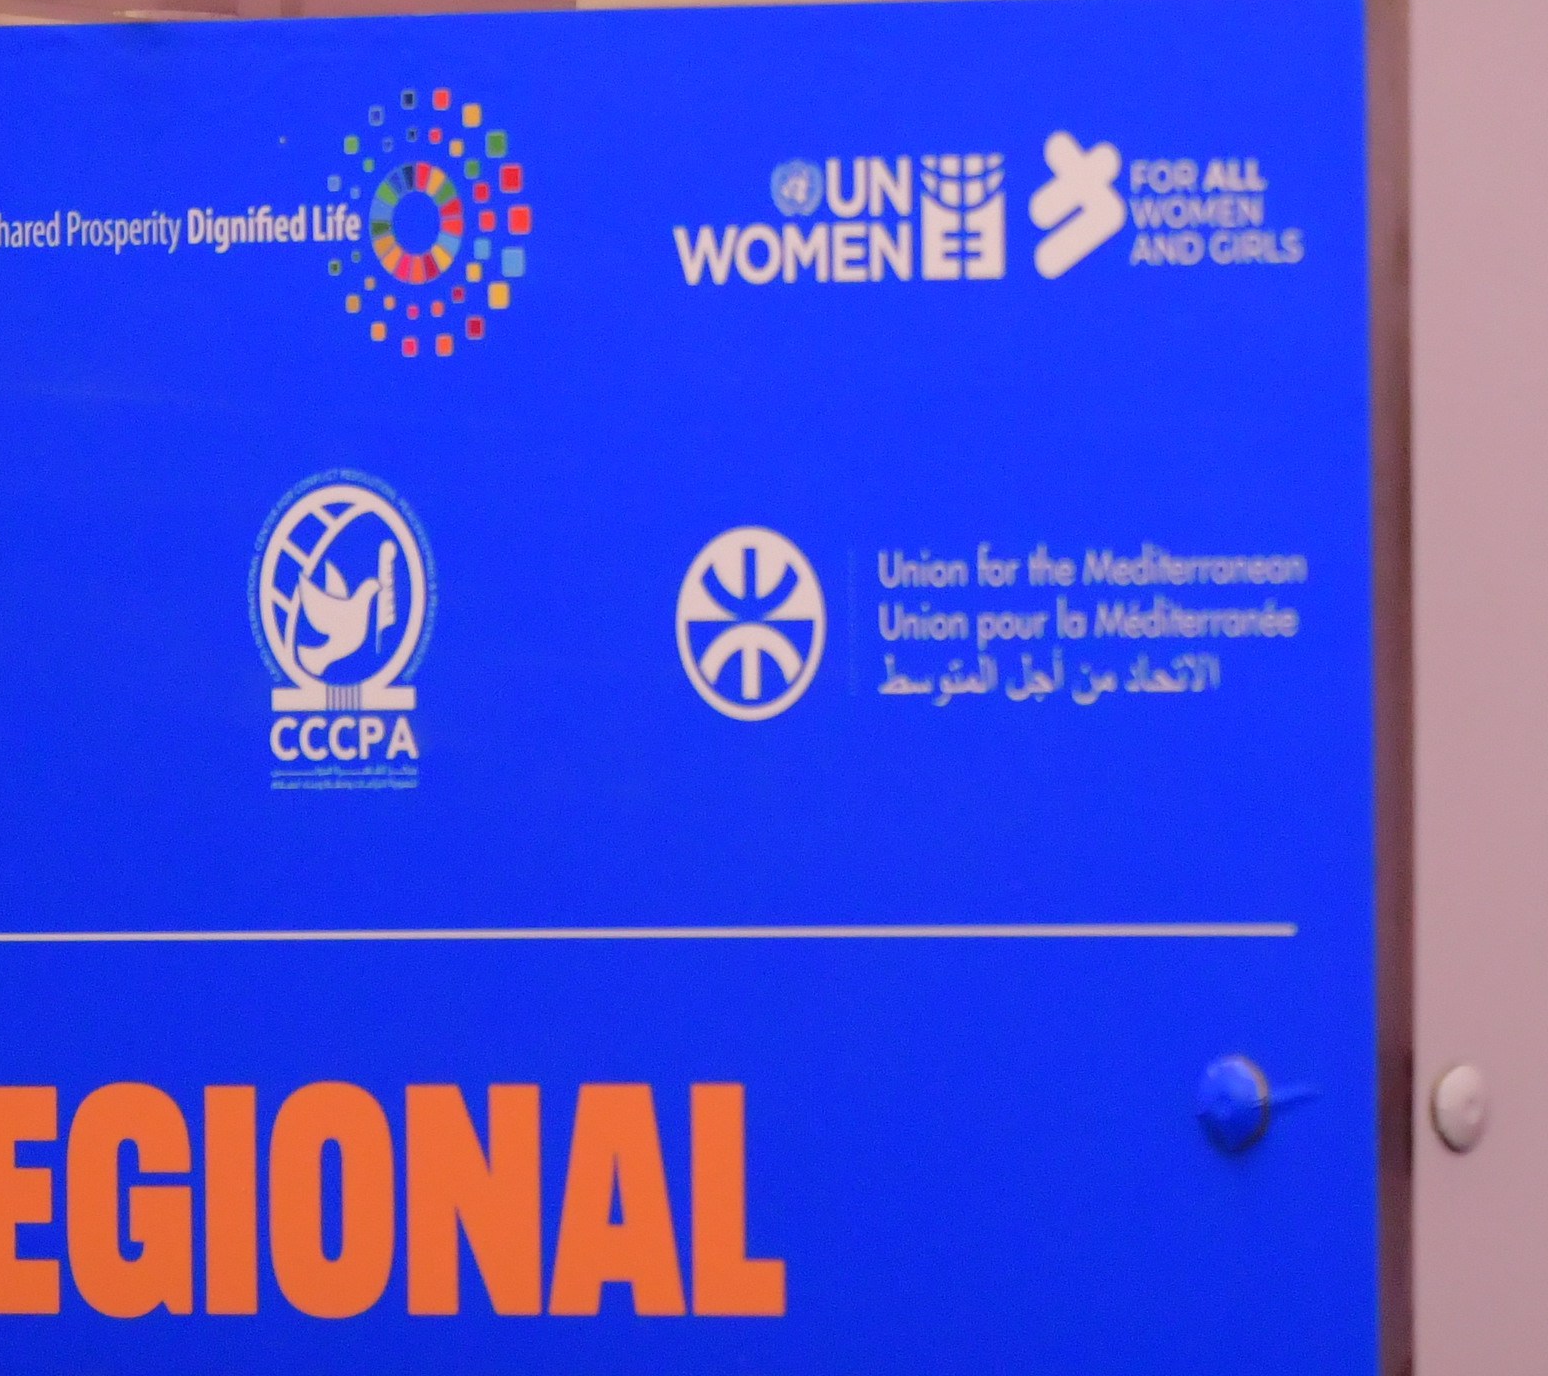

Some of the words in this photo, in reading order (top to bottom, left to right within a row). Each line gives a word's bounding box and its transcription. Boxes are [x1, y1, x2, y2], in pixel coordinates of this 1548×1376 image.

[825, 157, 913, 218] UN
[1129, 159, 1199, 193] FOR
[1203, 157, 1268, 193] ALL
[66, 209, 182, 255] Prosperity
[186, 203, 307, 254] Dignified
[311, 201, 362, 242] Life
[1129, 195, 1265, 230] WOMEN
[672, 221, 913, 287] WOMEN
[1128, 232, 1206, 267] AND
[1207, 229, 1305, 265] GIRLS
[877, 548, 970, 589] Union
[977, 541, 1022, 588] for
[1026, 541, 1077, 587] the
[1081, 541, 1309, 587] Mediterranean
[877, 600, 970, 642] Union
[977, 610, 1051, 651] pour
[1055, 594, 1089, 640] la
[1093, 594, 1301, 640] Méditerranée
[877, 651, 1001, 708] المتوسط
[1071, 661, 1120, 707] من
[269, 716, 420, 762] CCCPA
